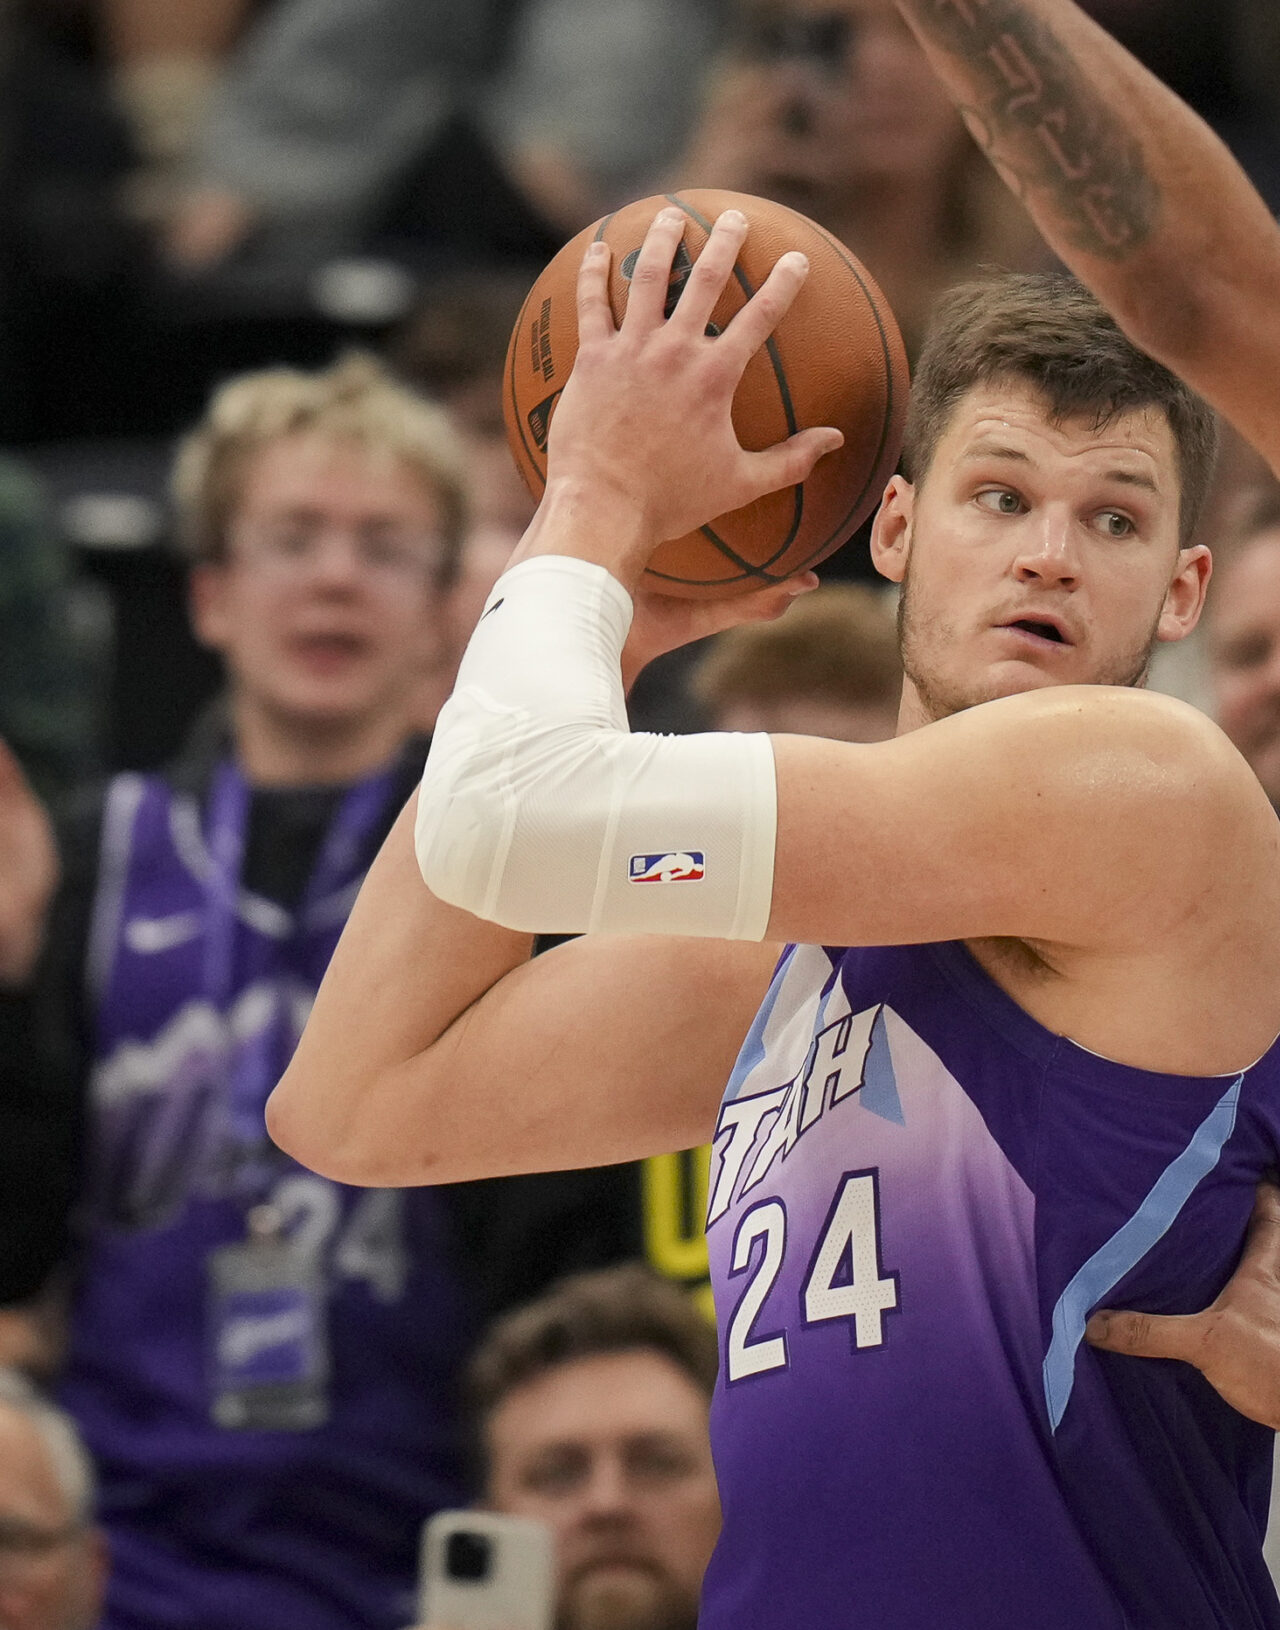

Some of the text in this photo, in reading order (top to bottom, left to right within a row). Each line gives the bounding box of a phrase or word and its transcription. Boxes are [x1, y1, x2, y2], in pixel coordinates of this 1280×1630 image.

[542, 357, 555, 383] BALL
[705, 1002, 883, 1234] TAH
[726, 1168, 900, 1387] 24
